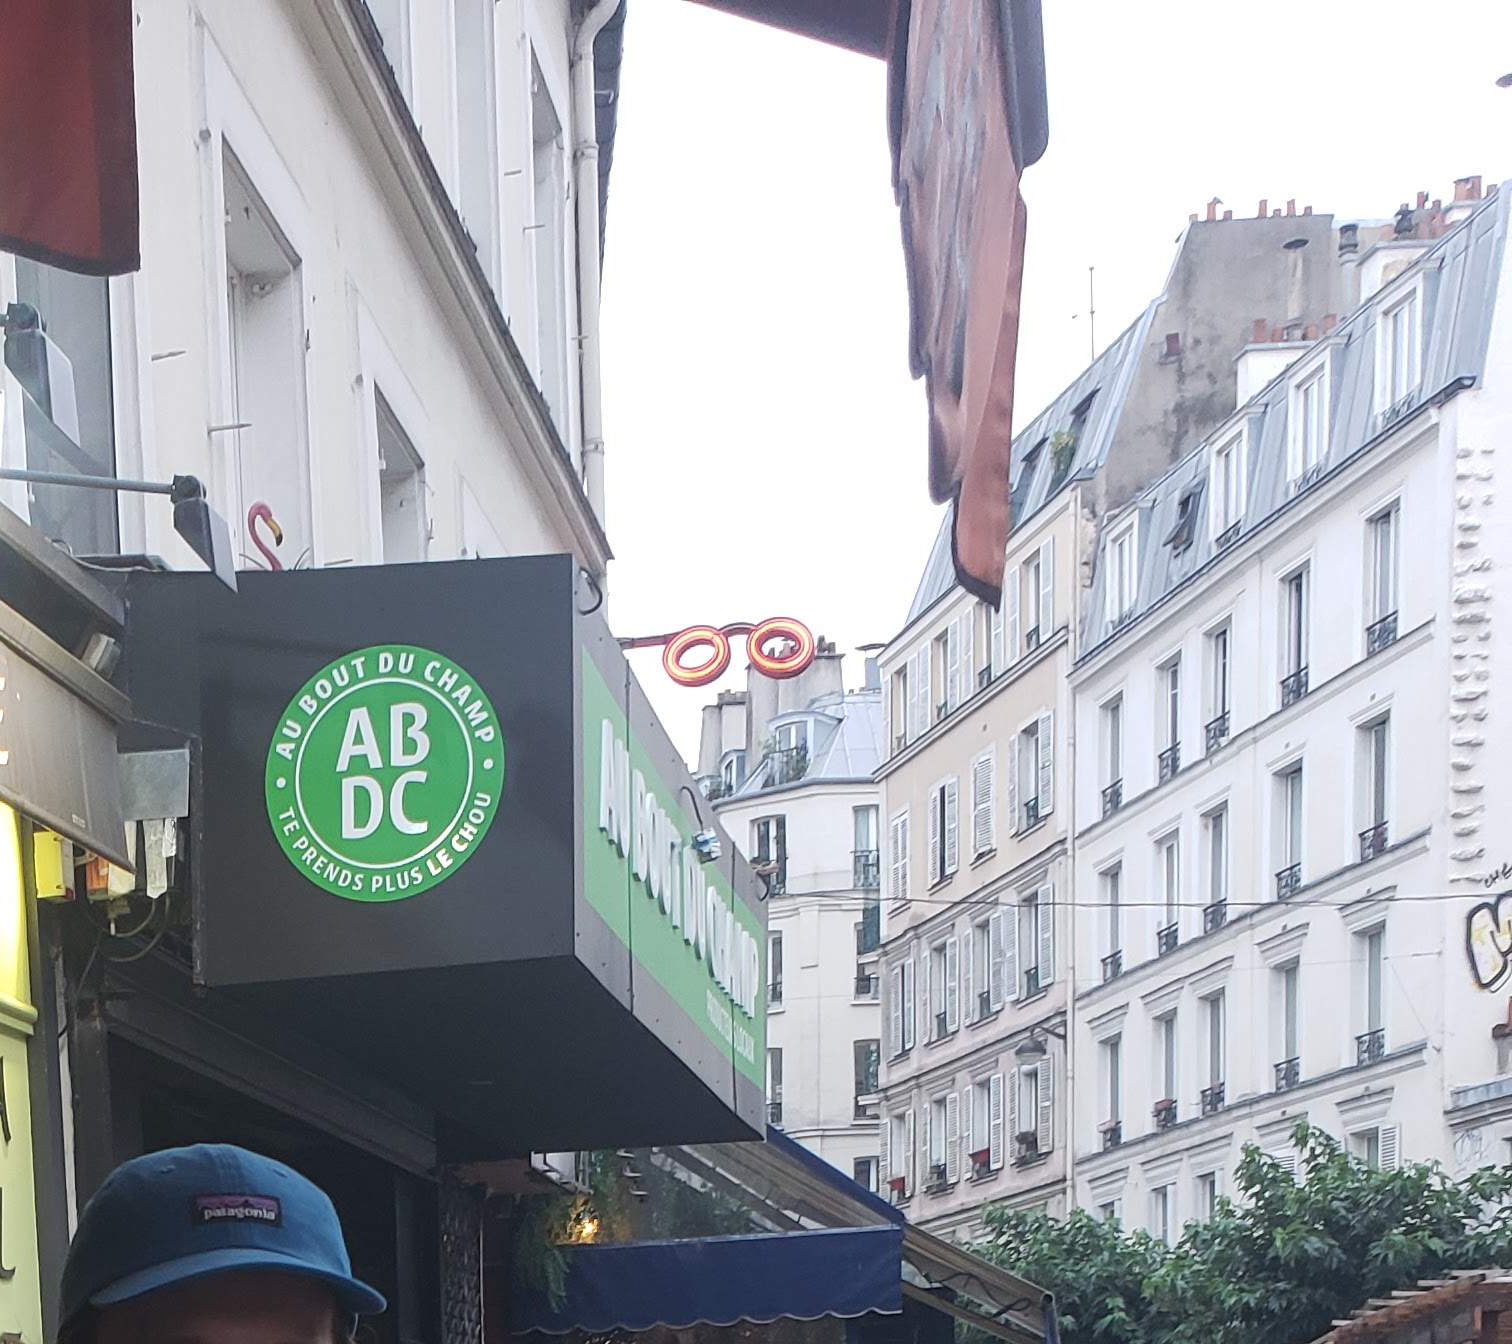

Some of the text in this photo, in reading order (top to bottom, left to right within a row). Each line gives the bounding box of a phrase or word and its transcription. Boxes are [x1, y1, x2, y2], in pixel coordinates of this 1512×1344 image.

[276, 652, 495, 760] AU BOUT DU CHAMP
[336, 702, 430, 772] AB
[279, 792, 491, 893] TE PRENDS PLUS LE CHOU
[342, 770, 428, 839] DC
[599, 718, 630, 858] AU
[632, 768, 682, 930] BOUT
[204, 1206, 276, 1221] patagonia
